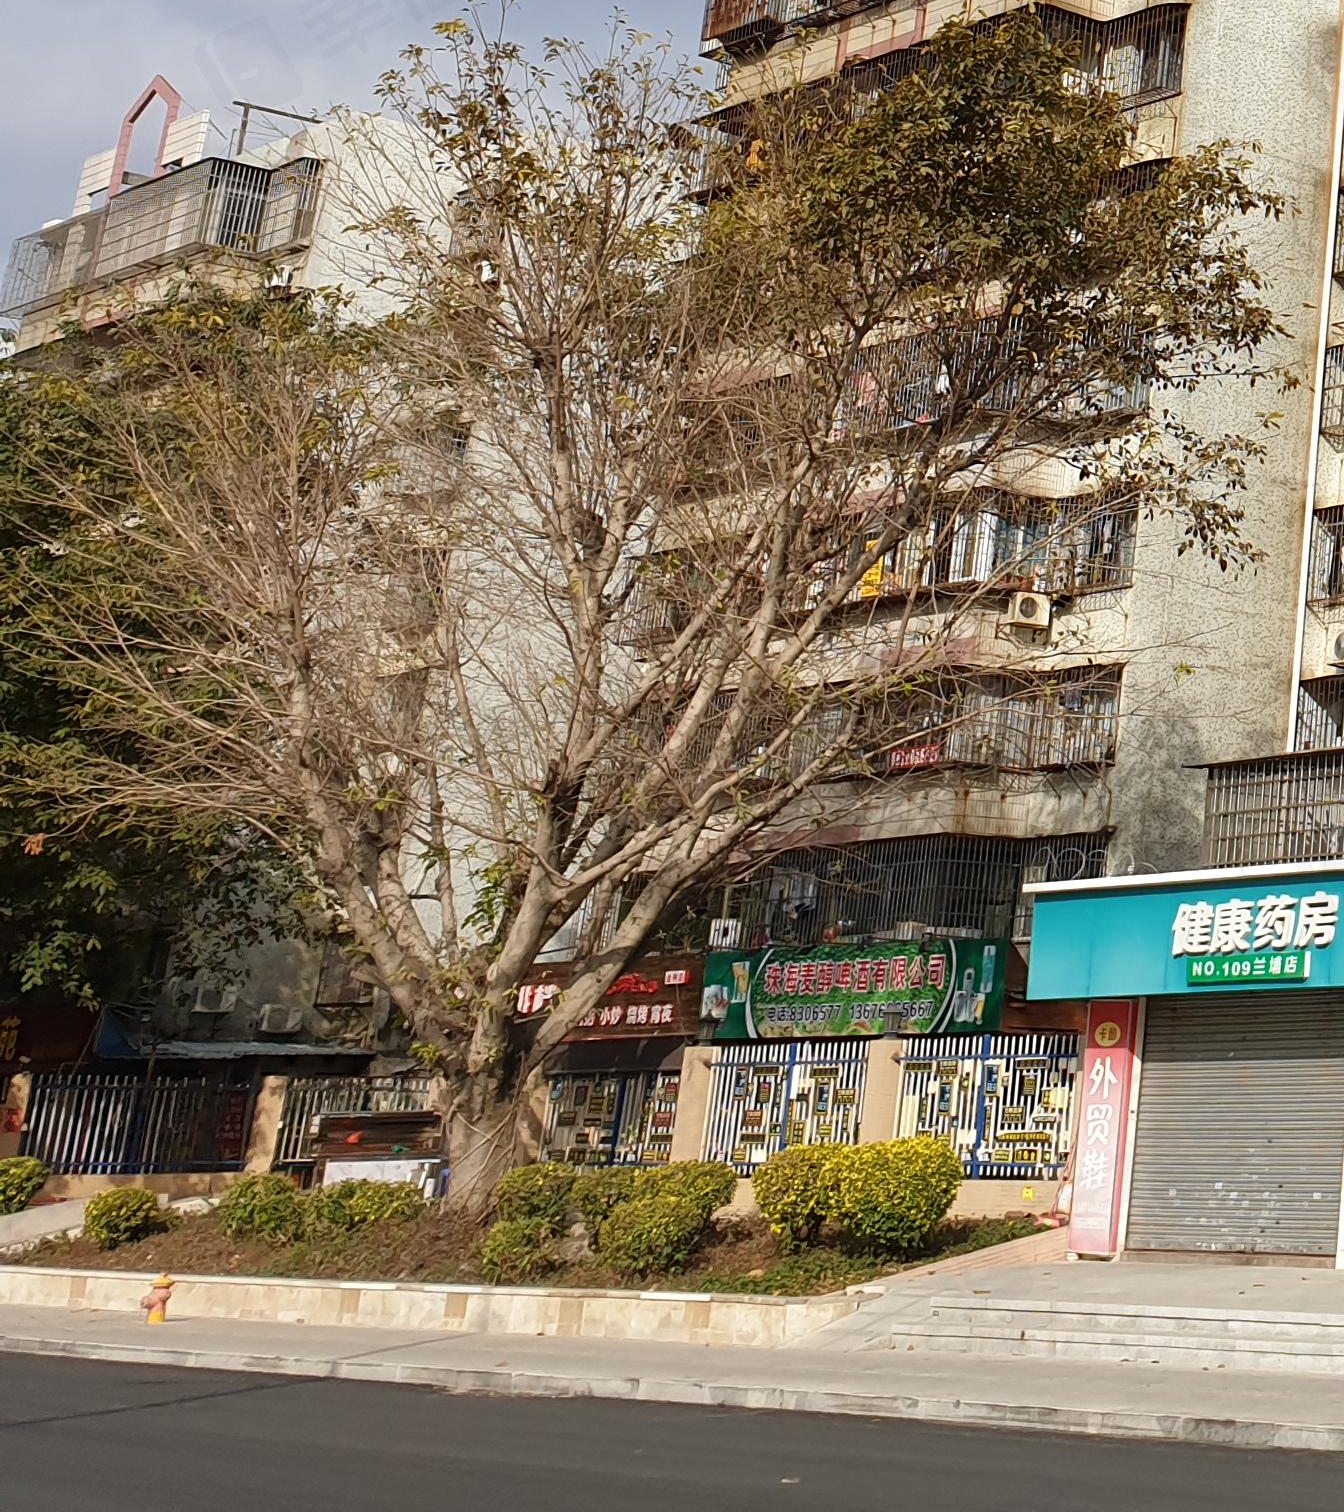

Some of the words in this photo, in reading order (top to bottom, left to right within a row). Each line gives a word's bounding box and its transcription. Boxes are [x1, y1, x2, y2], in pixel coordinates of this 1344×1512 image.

[1172, 891, 1340, 958] 健康药房
[1079, 1055, 1119, 1191] 外贸鞋
